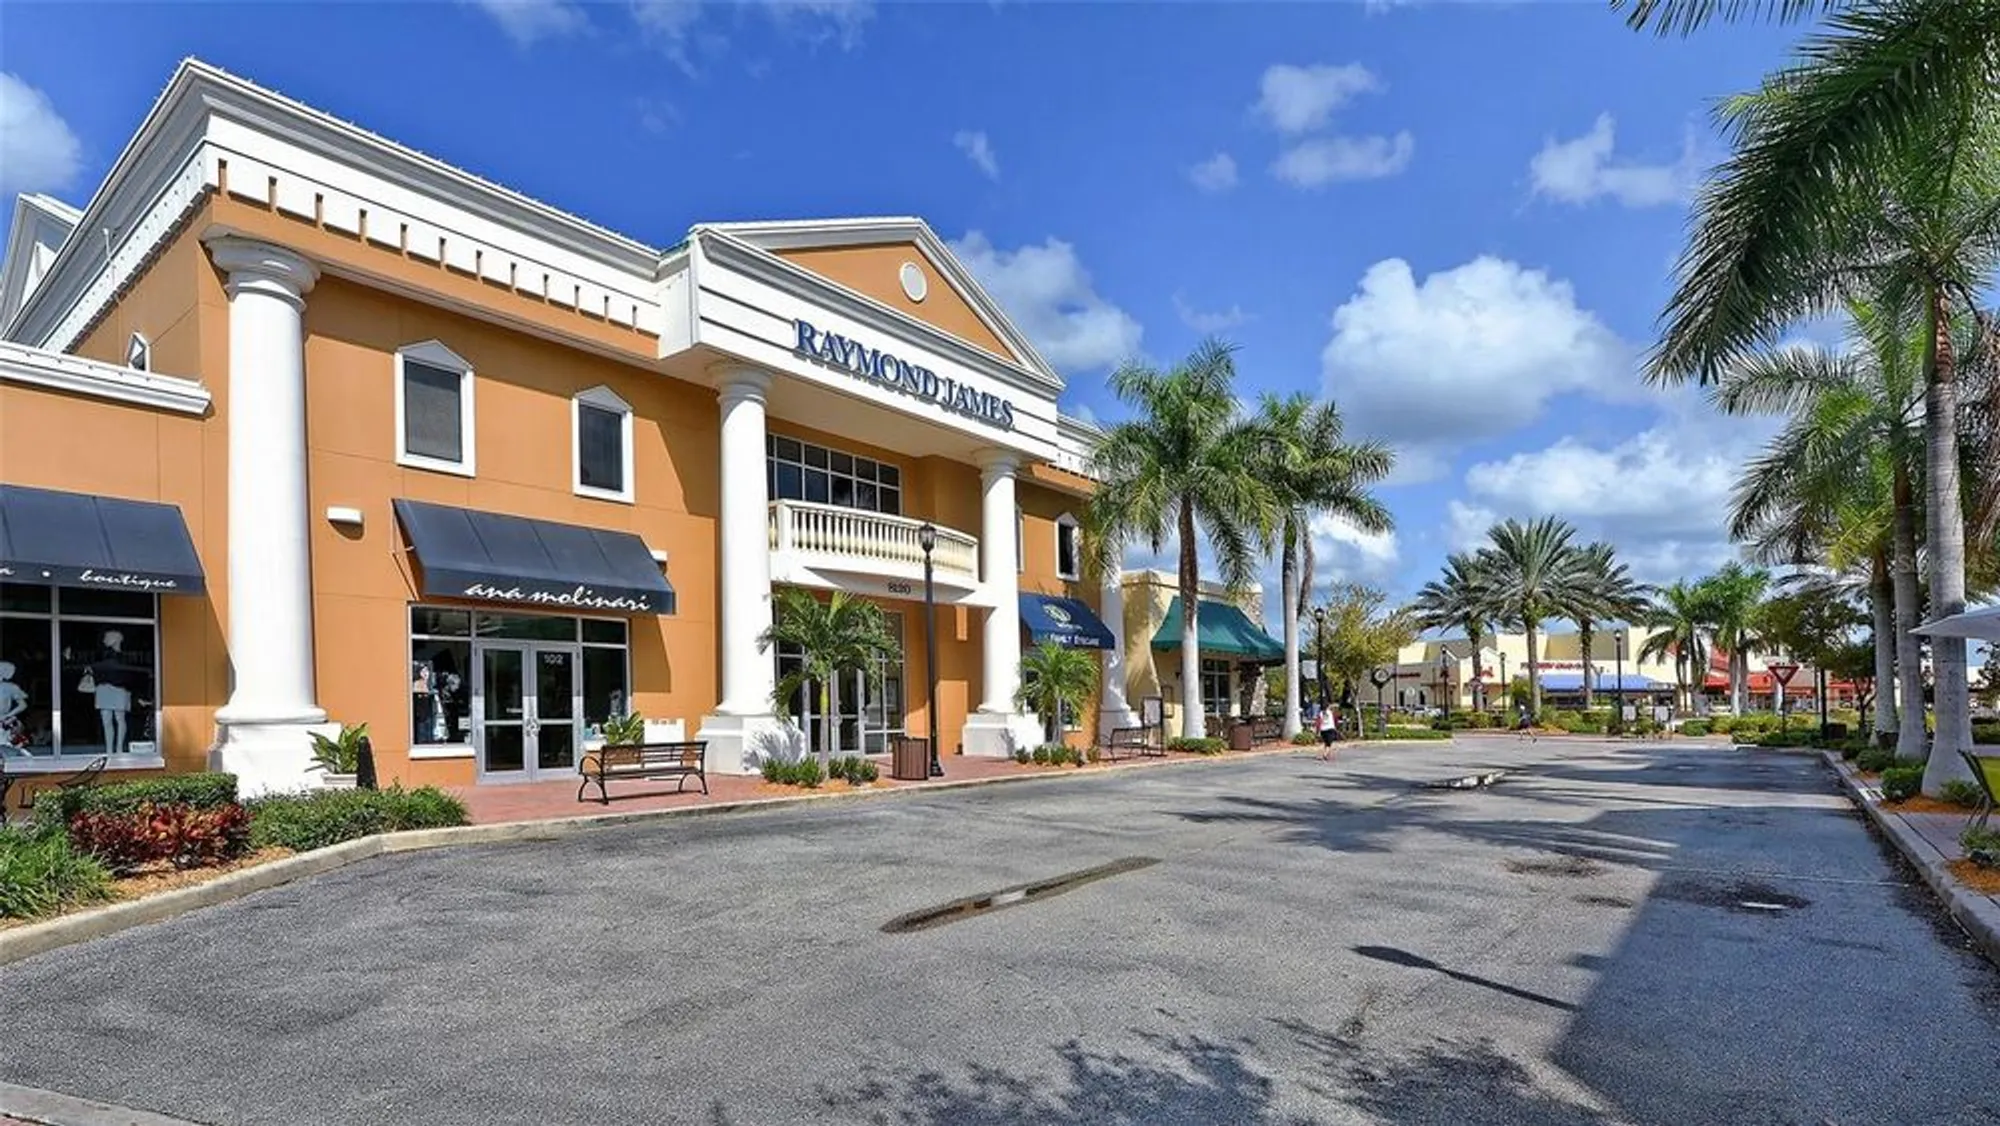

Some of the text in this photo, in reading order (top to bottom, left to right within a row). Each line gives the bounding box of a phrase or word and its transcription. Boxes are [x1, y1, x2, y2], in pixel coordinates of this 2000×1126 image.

[794, 318, 1014, 428] RAYMOND JAMES
[80, 569, 177, 590] boutique
[464, 583, 651, 611] ana molinari
[544, 653, 564, 665] 102
